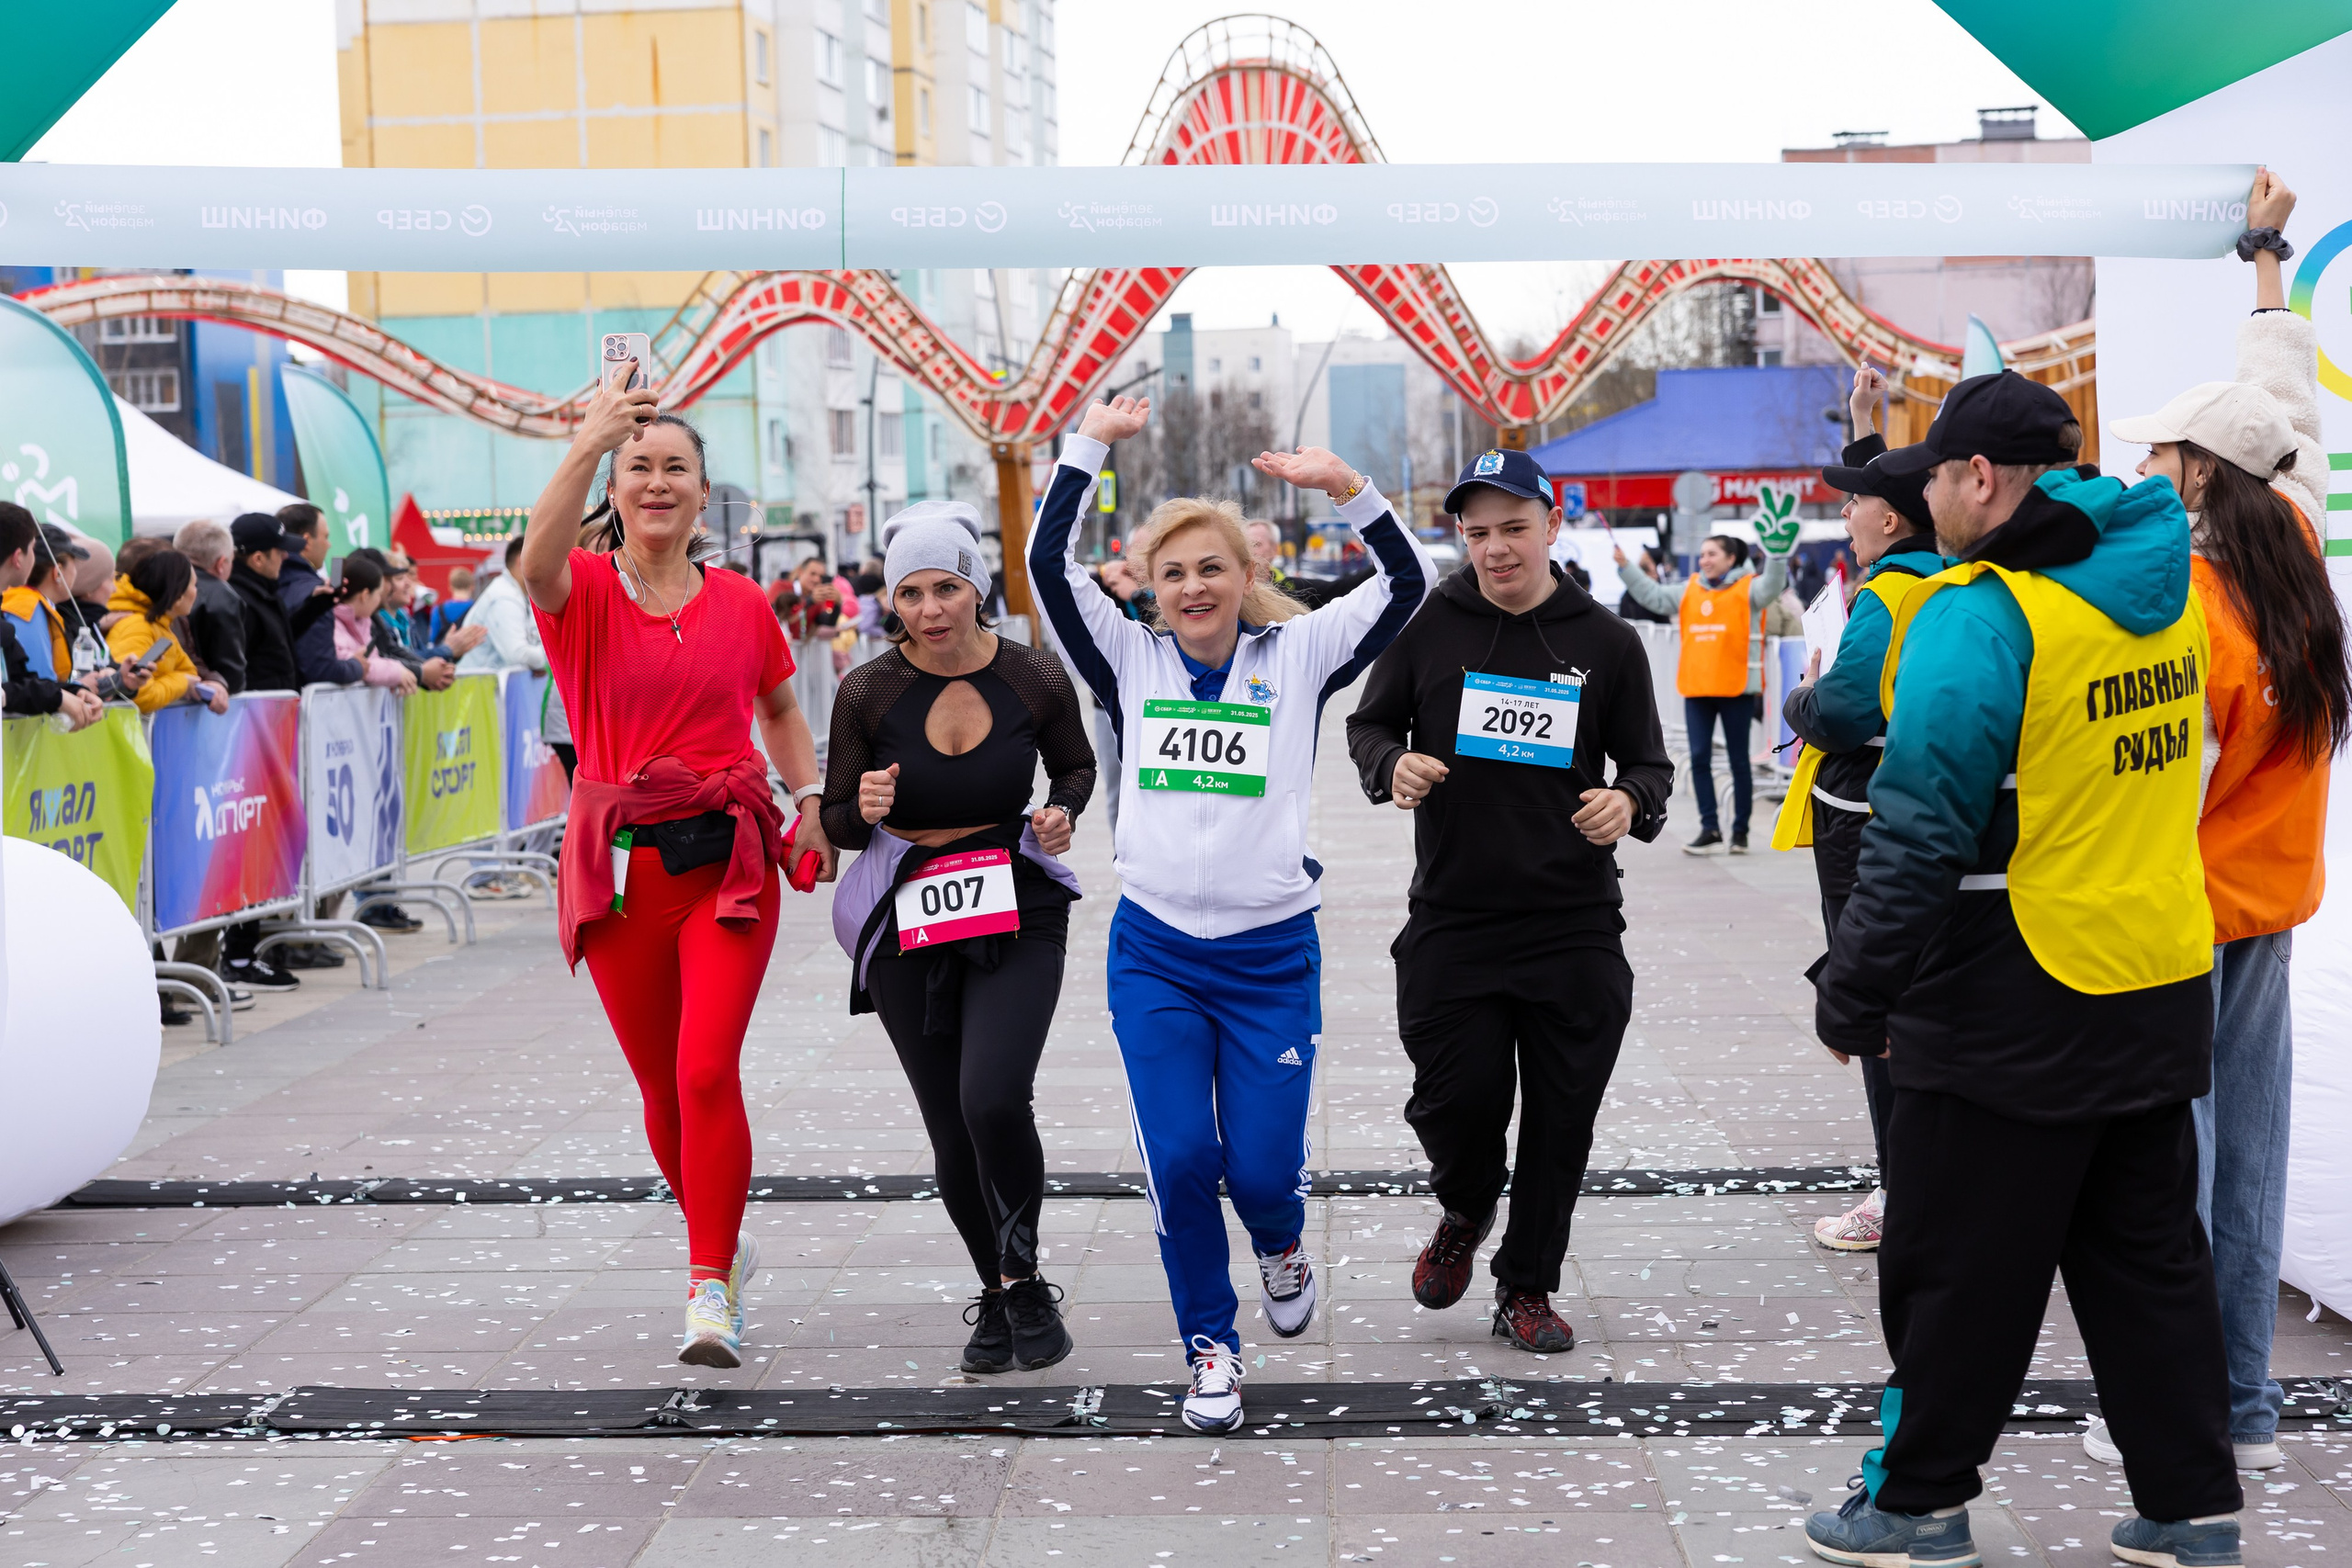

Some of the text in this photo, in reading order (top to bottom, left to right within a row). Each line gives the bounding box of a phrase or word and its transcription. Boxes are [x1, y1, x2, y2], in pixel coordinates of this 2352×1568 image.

[1550, 672, 1582, 686] PUMA
[2087, 646, 2199, 722] ГЛАВНЫЙ
[1544, 687, 1569, 695] 31.05.2025
[1501, 698, 1522, 706] 14-17
[1230, 710, 1259, 718] 31.05.2025
[1482, 706, 1553, 739] 2092
[1159, 727, 1246, 765] 4106
[1498, 744, 1520, 758] 4,2
[2114, 717, 2188, 776] СУДЬЯ
[971, 854, 998, 863] 31.05.2025
[921, 875, 984, 916] 007
[1277, 1057, 1302, 1066] adidas
